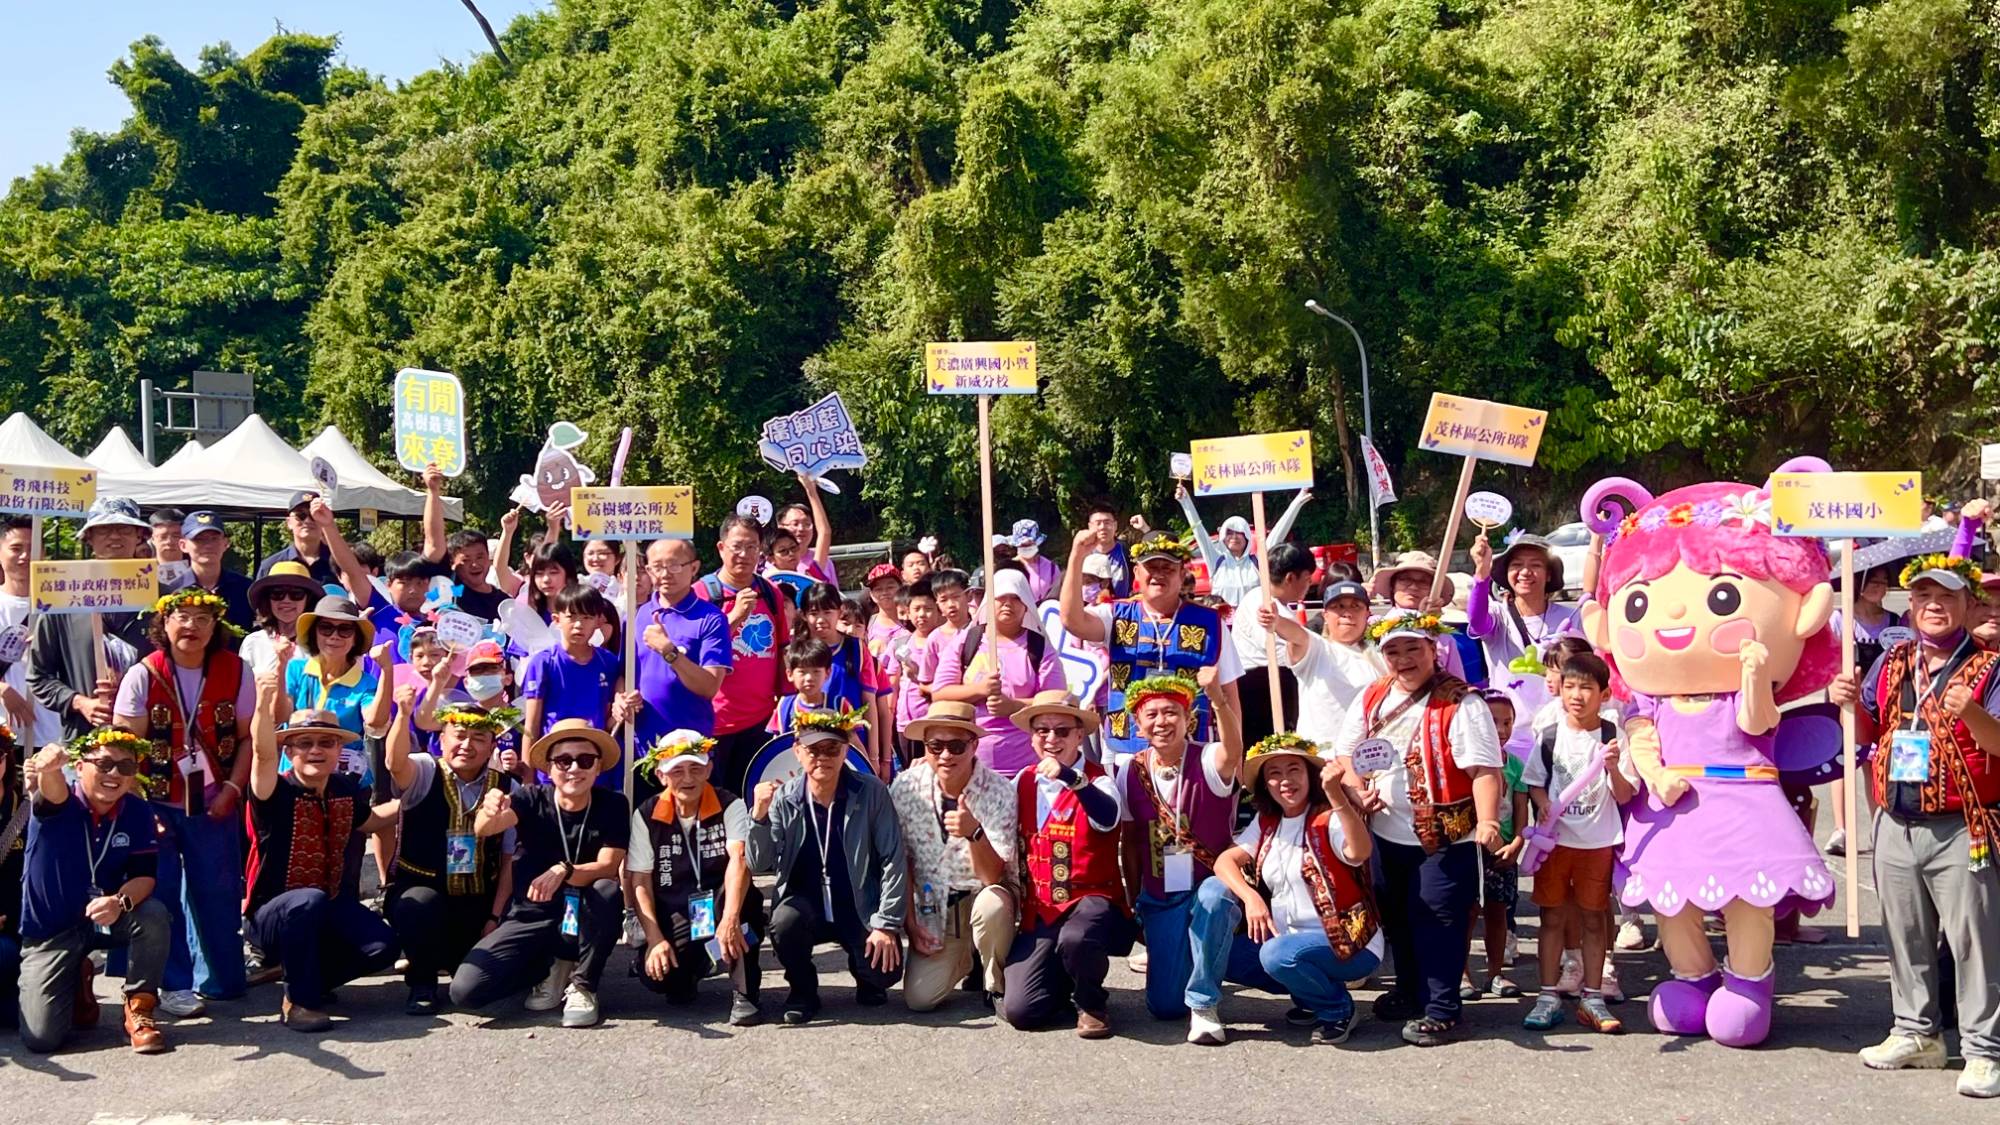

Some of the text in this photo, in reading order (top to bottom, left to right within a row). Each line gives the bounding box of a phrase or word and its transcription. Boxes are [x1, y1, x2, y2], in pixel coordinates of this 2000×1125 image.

[935, 356, 1029, 371] 美濃廣興國小暨
[955, 374, 1009, 388] 新威分校
[1433, 420, 1530, 450] 茂林區公所B隊
[785, 430, 858, 468] 同心染
[1203, 457, 1302, 480] 茂林區公所A隊
[12, 478, 71, 495] 磐飛科技
[0, 494, 85, 513] 股份有限公司
[586, 501, 679, 517] 高樹鄉公所及
[1808, 502, 1884, 520] 茂林國小
[602, 519, 664, 535] 善導書院
[40, 578, 151, 593] 高雄市政府警察局
[68, 594, 124, 608] 六龜分局
[672, 833, 683, 856] 特助
